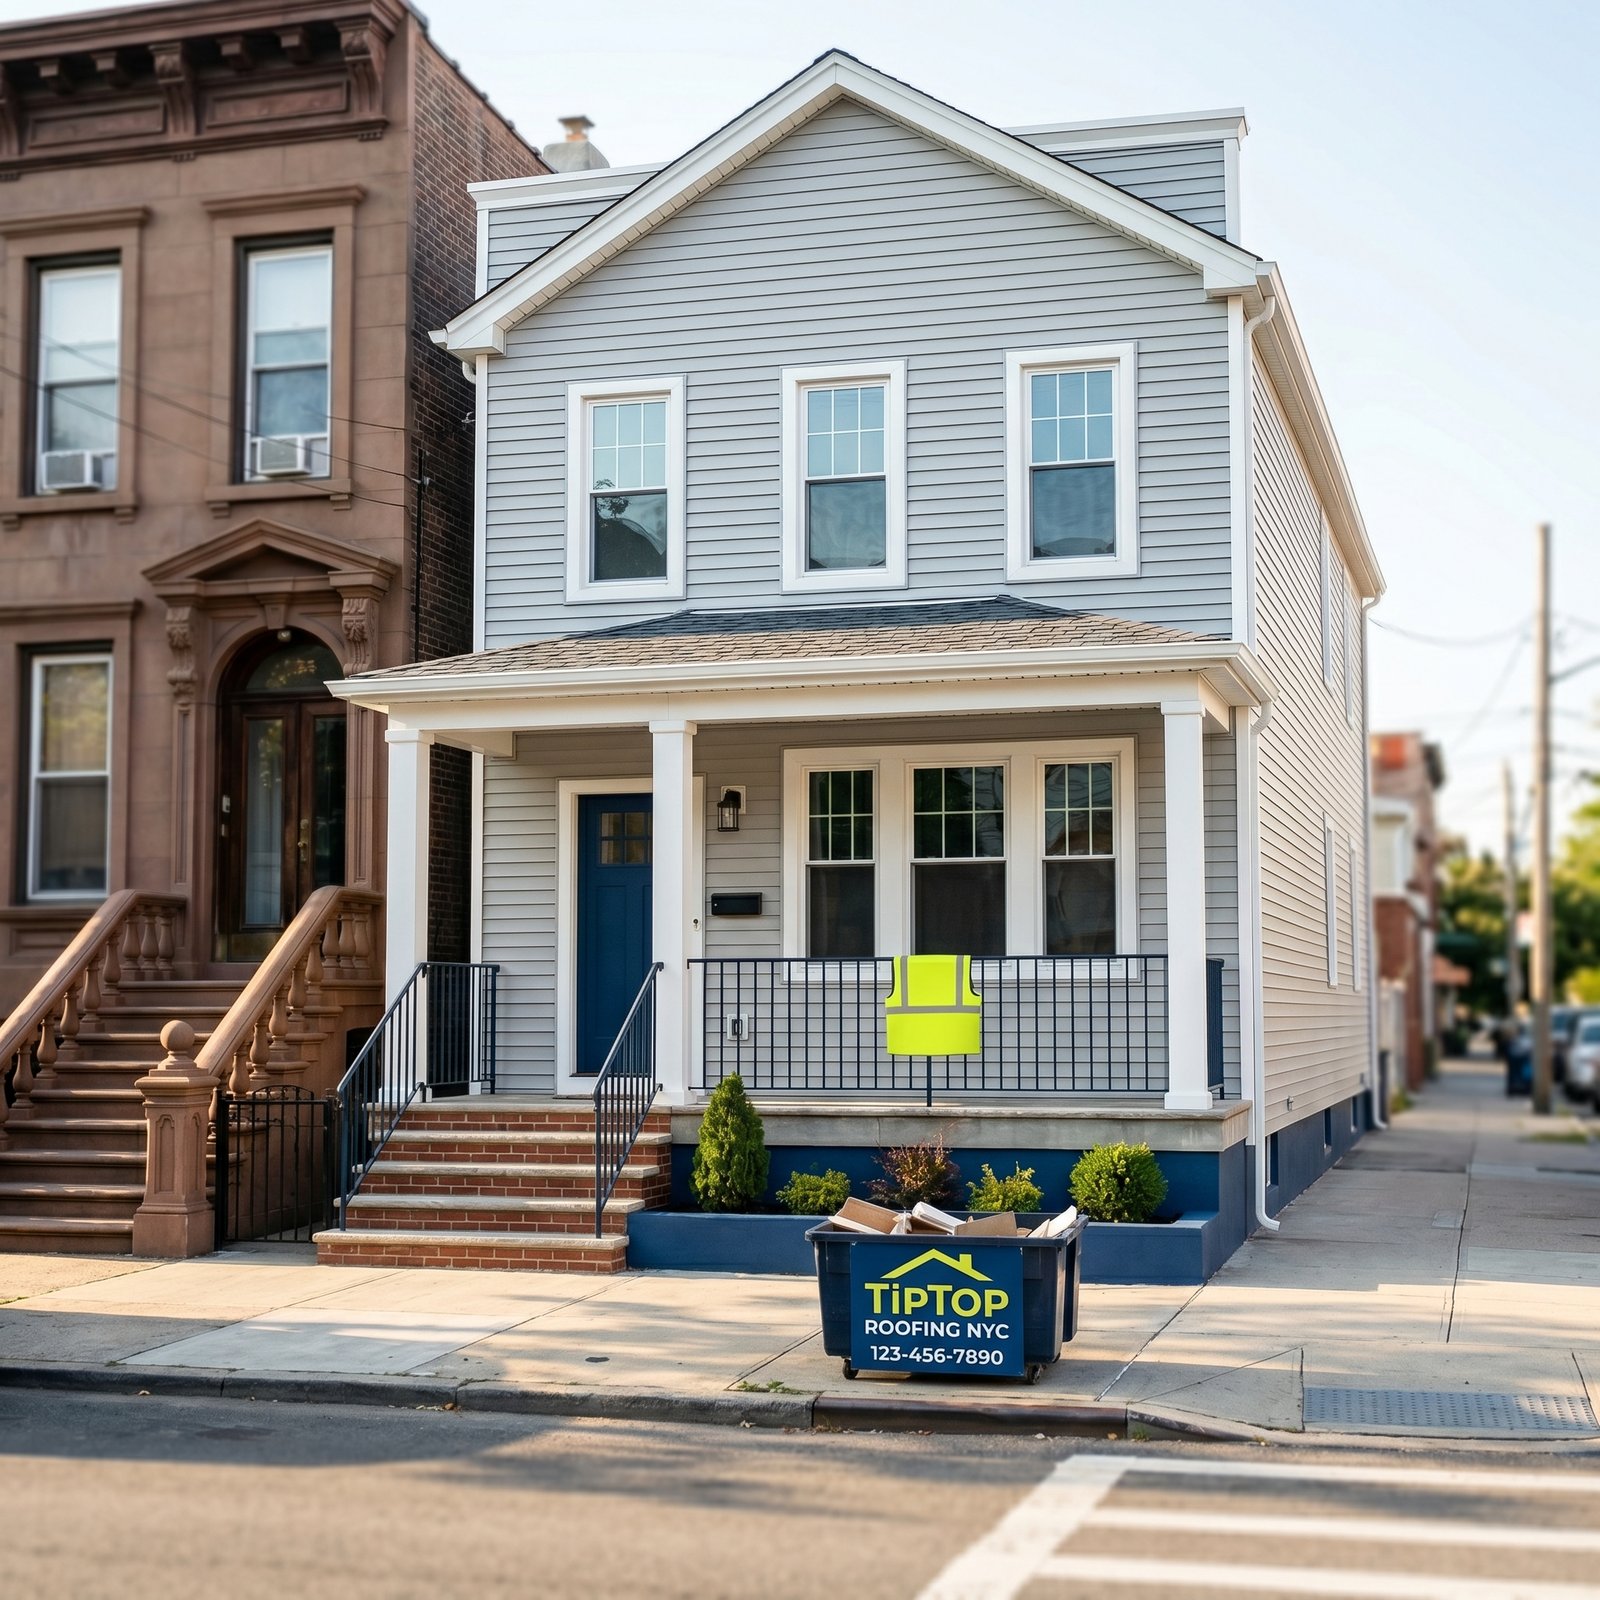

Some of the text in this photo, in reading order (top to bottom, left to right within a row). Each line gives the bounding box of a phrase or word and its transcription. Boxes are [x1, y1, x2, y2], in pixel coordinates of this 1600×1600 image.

[864, 1319, 1010, 1340] ROOFING NYC
[870, 1345, 1004, 1366] 123-456-7890
